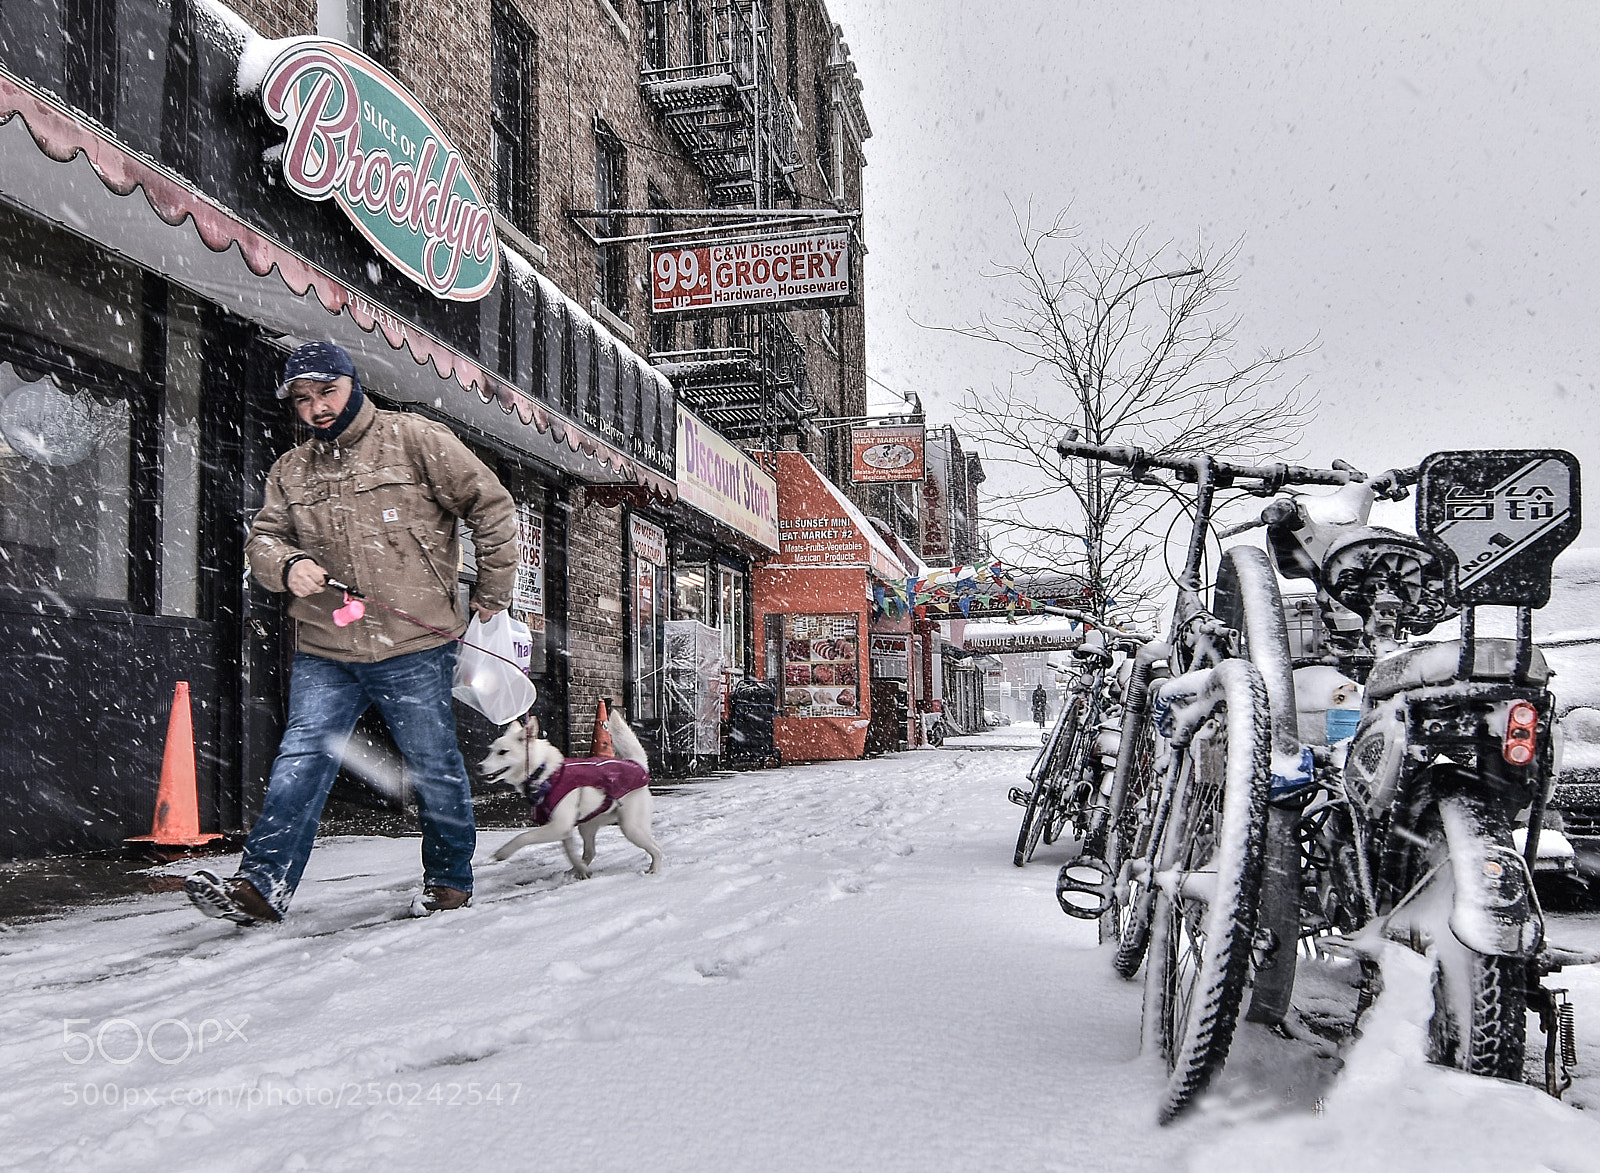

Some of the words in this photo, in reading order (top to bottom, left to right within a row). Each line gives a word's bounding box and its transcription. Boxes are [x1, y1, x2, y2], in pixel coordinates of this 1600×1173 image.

[363, 100, 398, 146] SLICE
[400, 135, 417, 162] OF
[264, 51, 494, 292] Brooklyn
[713, 244, 747, 262] C&W
[751, 239, 813, 259] Discount
[817, 237, 847, 250] Plus
[715, 250, 842, 289] GROCERY
[672, 295, 691, 308] UP
[714, 286, 777, 302] Hardware,
[778, 279, 848, 297] Houseware
[346, 289, 409, 339] PIZZERIA
[600, 416, 626, 446] Delivery
[684, 415, 742, 505] Discount
[743, 461, 771, 522] Store
[779, 520, 793, 529] ELI
[794, 518, 829, 528] SUNSET
[831, 517, 850, 527] MINI
[532, 527, 542, 548] PIE
[801, 530, 839, 540] MARKET
[841, 529, 853, 539] #2
[784, 541, 863, 553] Meats-Fruits-Vegetables
[794, 553, 821, 562] Mexican
[824, 552, 856, 561] Products
[872, 639, 907, 651] ATM
[970, 636, 1011, 648] INSTITUTE
[1015, 635, 1035, 647] ALFA
[1038, 635, 1044, 645] Y
